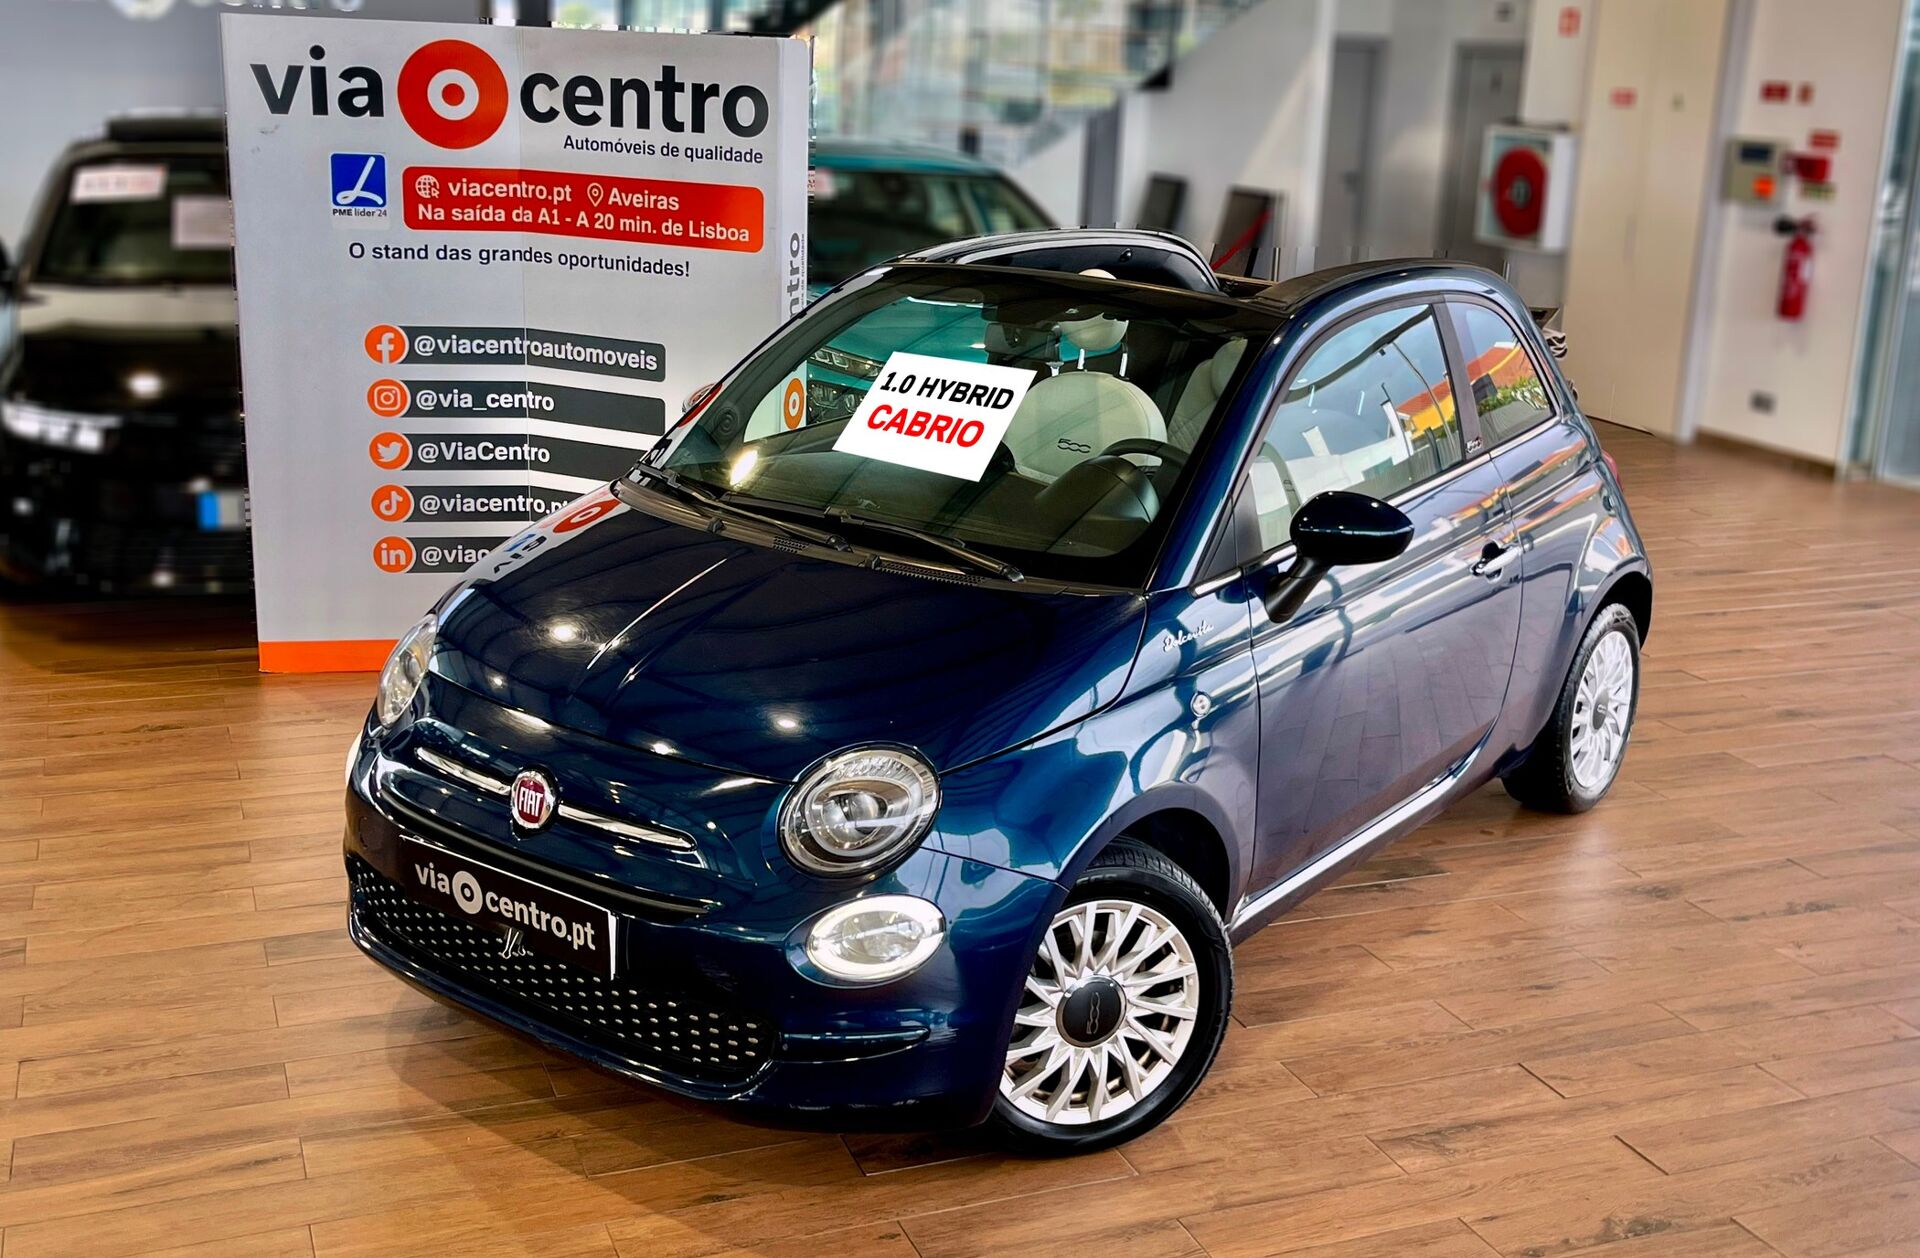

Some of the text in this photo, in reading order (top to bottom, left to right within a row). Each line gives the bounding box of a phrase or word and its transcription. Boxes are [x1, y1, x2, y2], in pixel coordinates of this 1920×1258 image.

[250, 45, 769, 138] via centro
[564, 135, 763, 163] Automóveis de qualidade
[448, 178, 572, 205] viacentro.pt
[608, 188, 680, 210] Aveiras
[332, 208, 352, 217] PME
[418, 204, 445, 221] Na
[452, 204, 505, 222] saída
[512, 206, 533, 223] da
[538, 208, 560, 225] A1
[576, 211, 589, 228] A
[594, 213, 614, 230] 20
[619, 216, 657, 234] min.
[661, 219, 683, 236] de
[689, 221, 750, 242] Lisboa
[349, 242, 690, 277] O stand das grandes oportunidades!
[413, 335, 658, 371] @viacentroautomoveis
[415, 389, 555, 412] @via_centro
[880, 372, 1015, 410] 1.0 HYBRID
[867, 404, 985, 448] CABRIO
[417, 442, 551, 464] @ViaCentro
[518, 786, 544, 817] FIAT
[415, 862, 596, 950] via centro.pt
